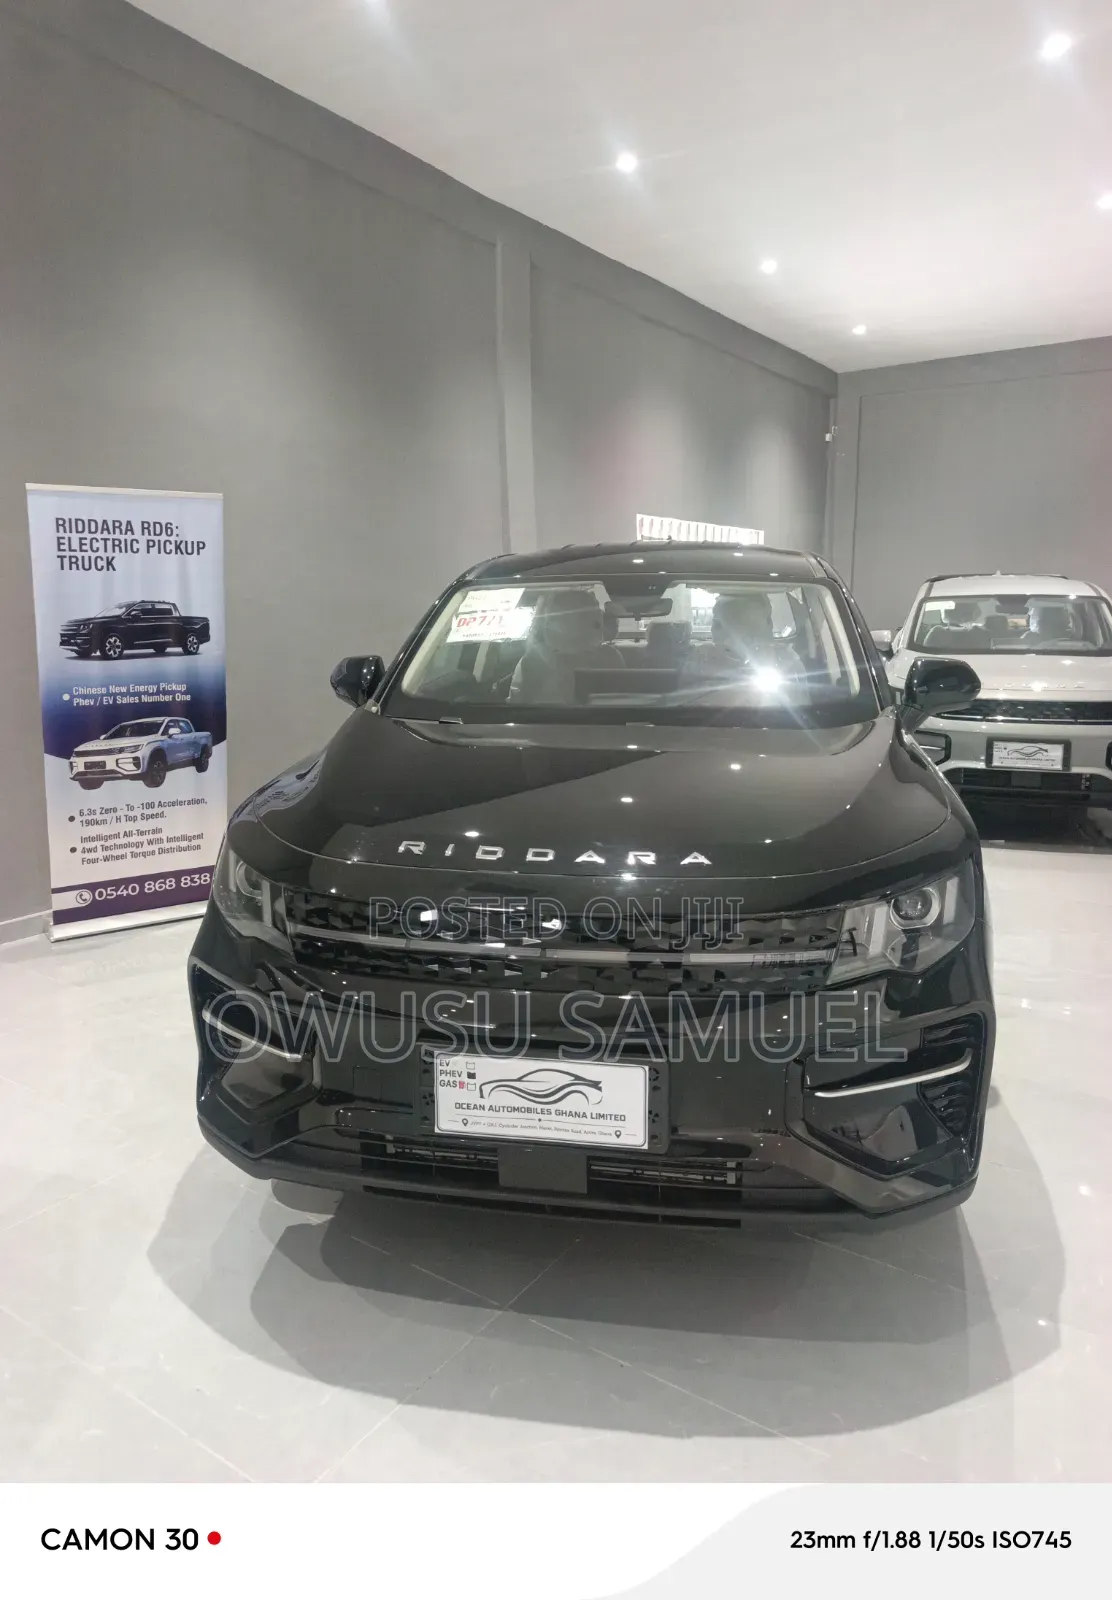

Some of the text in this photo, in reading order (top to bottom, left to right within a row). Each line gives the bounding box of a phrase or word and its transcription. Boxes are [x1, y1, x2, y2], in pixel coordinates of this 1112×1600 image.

[55, 517, 180, 537] RIDDARA RD6:
[56, 536, 206, 556] ELECTRIC PICKUP
[57, 555, 116, 572] TRUCK
[72, 682, 187, 695] Chinese New Energy Pickup
[73, 697, 94, 706] Phev
[103, 696, 114, 705] EV
[116, 695, 139, 704] Sales
[141, 693, 173, 703] Number
[175, 692, 191, 701] One
[79, 808, 97, 817] 6.3s
[99, 806, 118, 815] Zero
[125, 804, 135, 812] To
[136, 801, 155, 810] -100
[80, 818, 108, 827] 190km
[115, 815, 122, 823] H
[124, 814, 138, 823] Top
[140, 811, 167, 821] Speed.
[80, 827, 163, 844] Intelligent All-Terrain
[80, 832, 204, 854] 4wd Technology With Intelligent
[81, 843, 201, 865] Four-Wheel Torque Distribution
[398, 840, 713, 865] RIDDARA
[94, 872, 211, 901] 0540 868 838
[439, 1069, 463, 1078] PHEV
[439, 1080, 458, 1089] GAS
[454, 1102, 626, 1122] OCEAN AUTOMOBILES GHANA LIMITED
